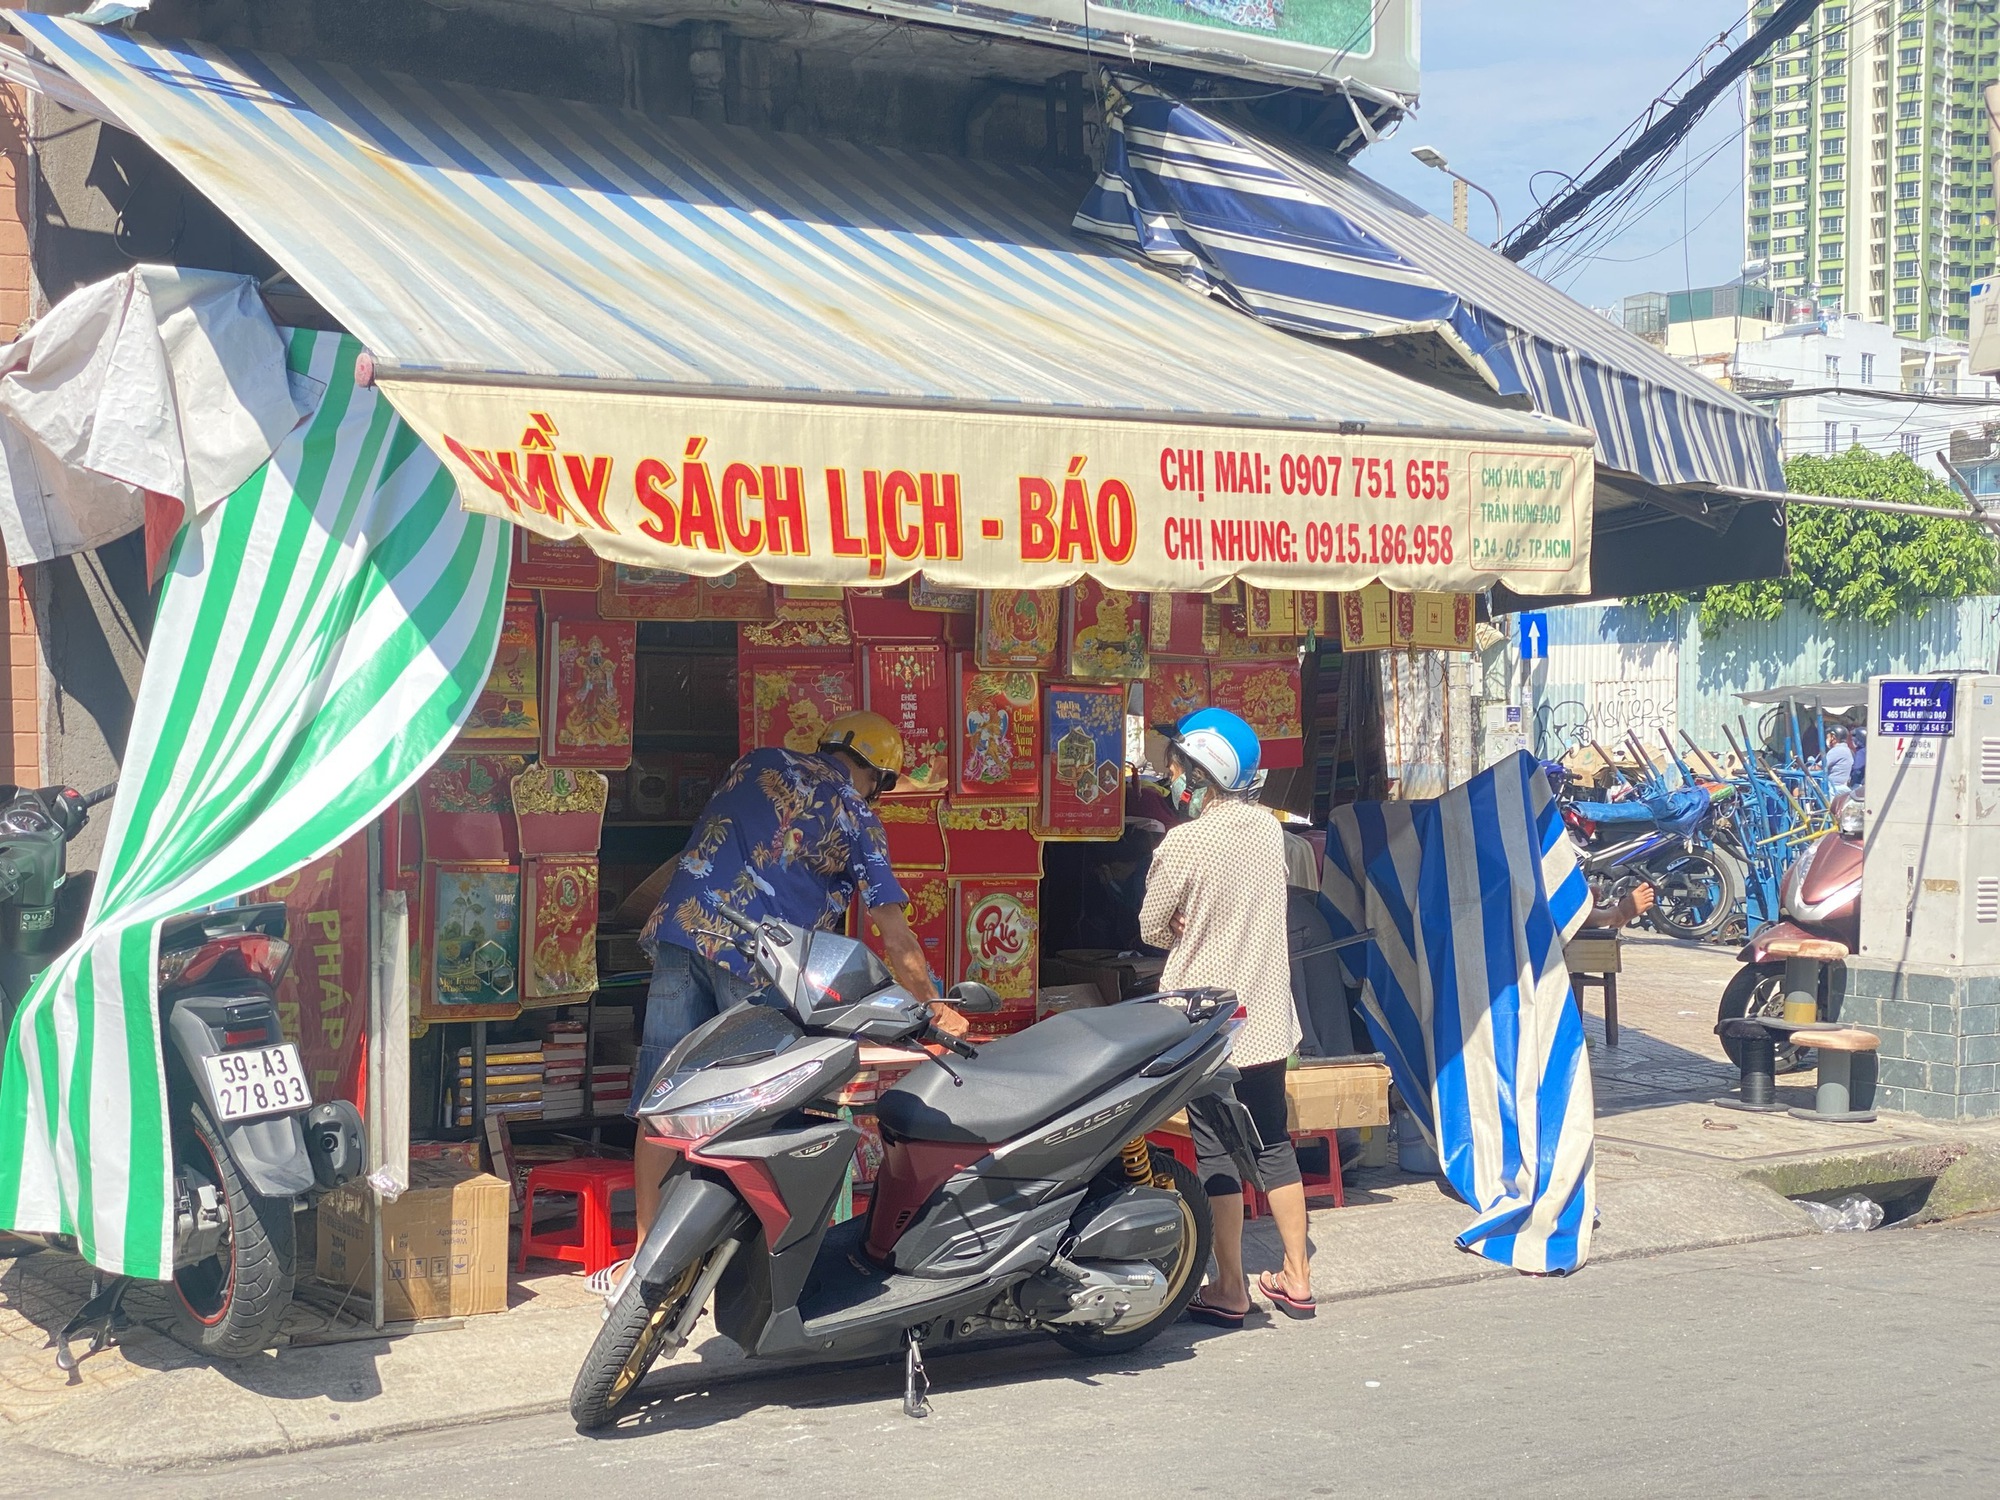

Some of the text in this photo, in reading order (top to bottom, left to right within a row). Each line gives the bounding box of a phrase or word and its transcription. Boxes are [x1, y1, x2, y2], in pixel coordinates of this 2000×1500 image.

[1160, 447, 1450, 502] CHỊ MAI: 0907 751 655
[1481, 466, 1503, 492] CHỢ
[635, 436, 810, 558] SÁCH
[825, 467, 962, 580] LỊCH
[1017, 454, 1138, 566] BÁO
[1480, 494, 1509, 523] TRẦN
[1164, 516, 1454, 571] CHỊ NHUNG: 0915.186.958
[1473, 537, 1497, 558] P.14
[1528, 538, 1571, 559] TP.HCM
[1892, 698, 1941, 707] PH2-PH3-1
[1907, 686, 1927, 696] TLK
[1886, 710, 1899, 719] 465
[1900, 708, 1916, 719] TRẦN
[1934, 711, 1947, 720] ĐẠO
[1904, 723, 1949, 732] 1900 54 54 54
[307, 909, 353, 1050] PHÁP
[219, 1049, 288, 1083] 59-A3
[220, 1077, 305, 1116] 278.93
[1043, 1100, 1134, 1145] CLICK
